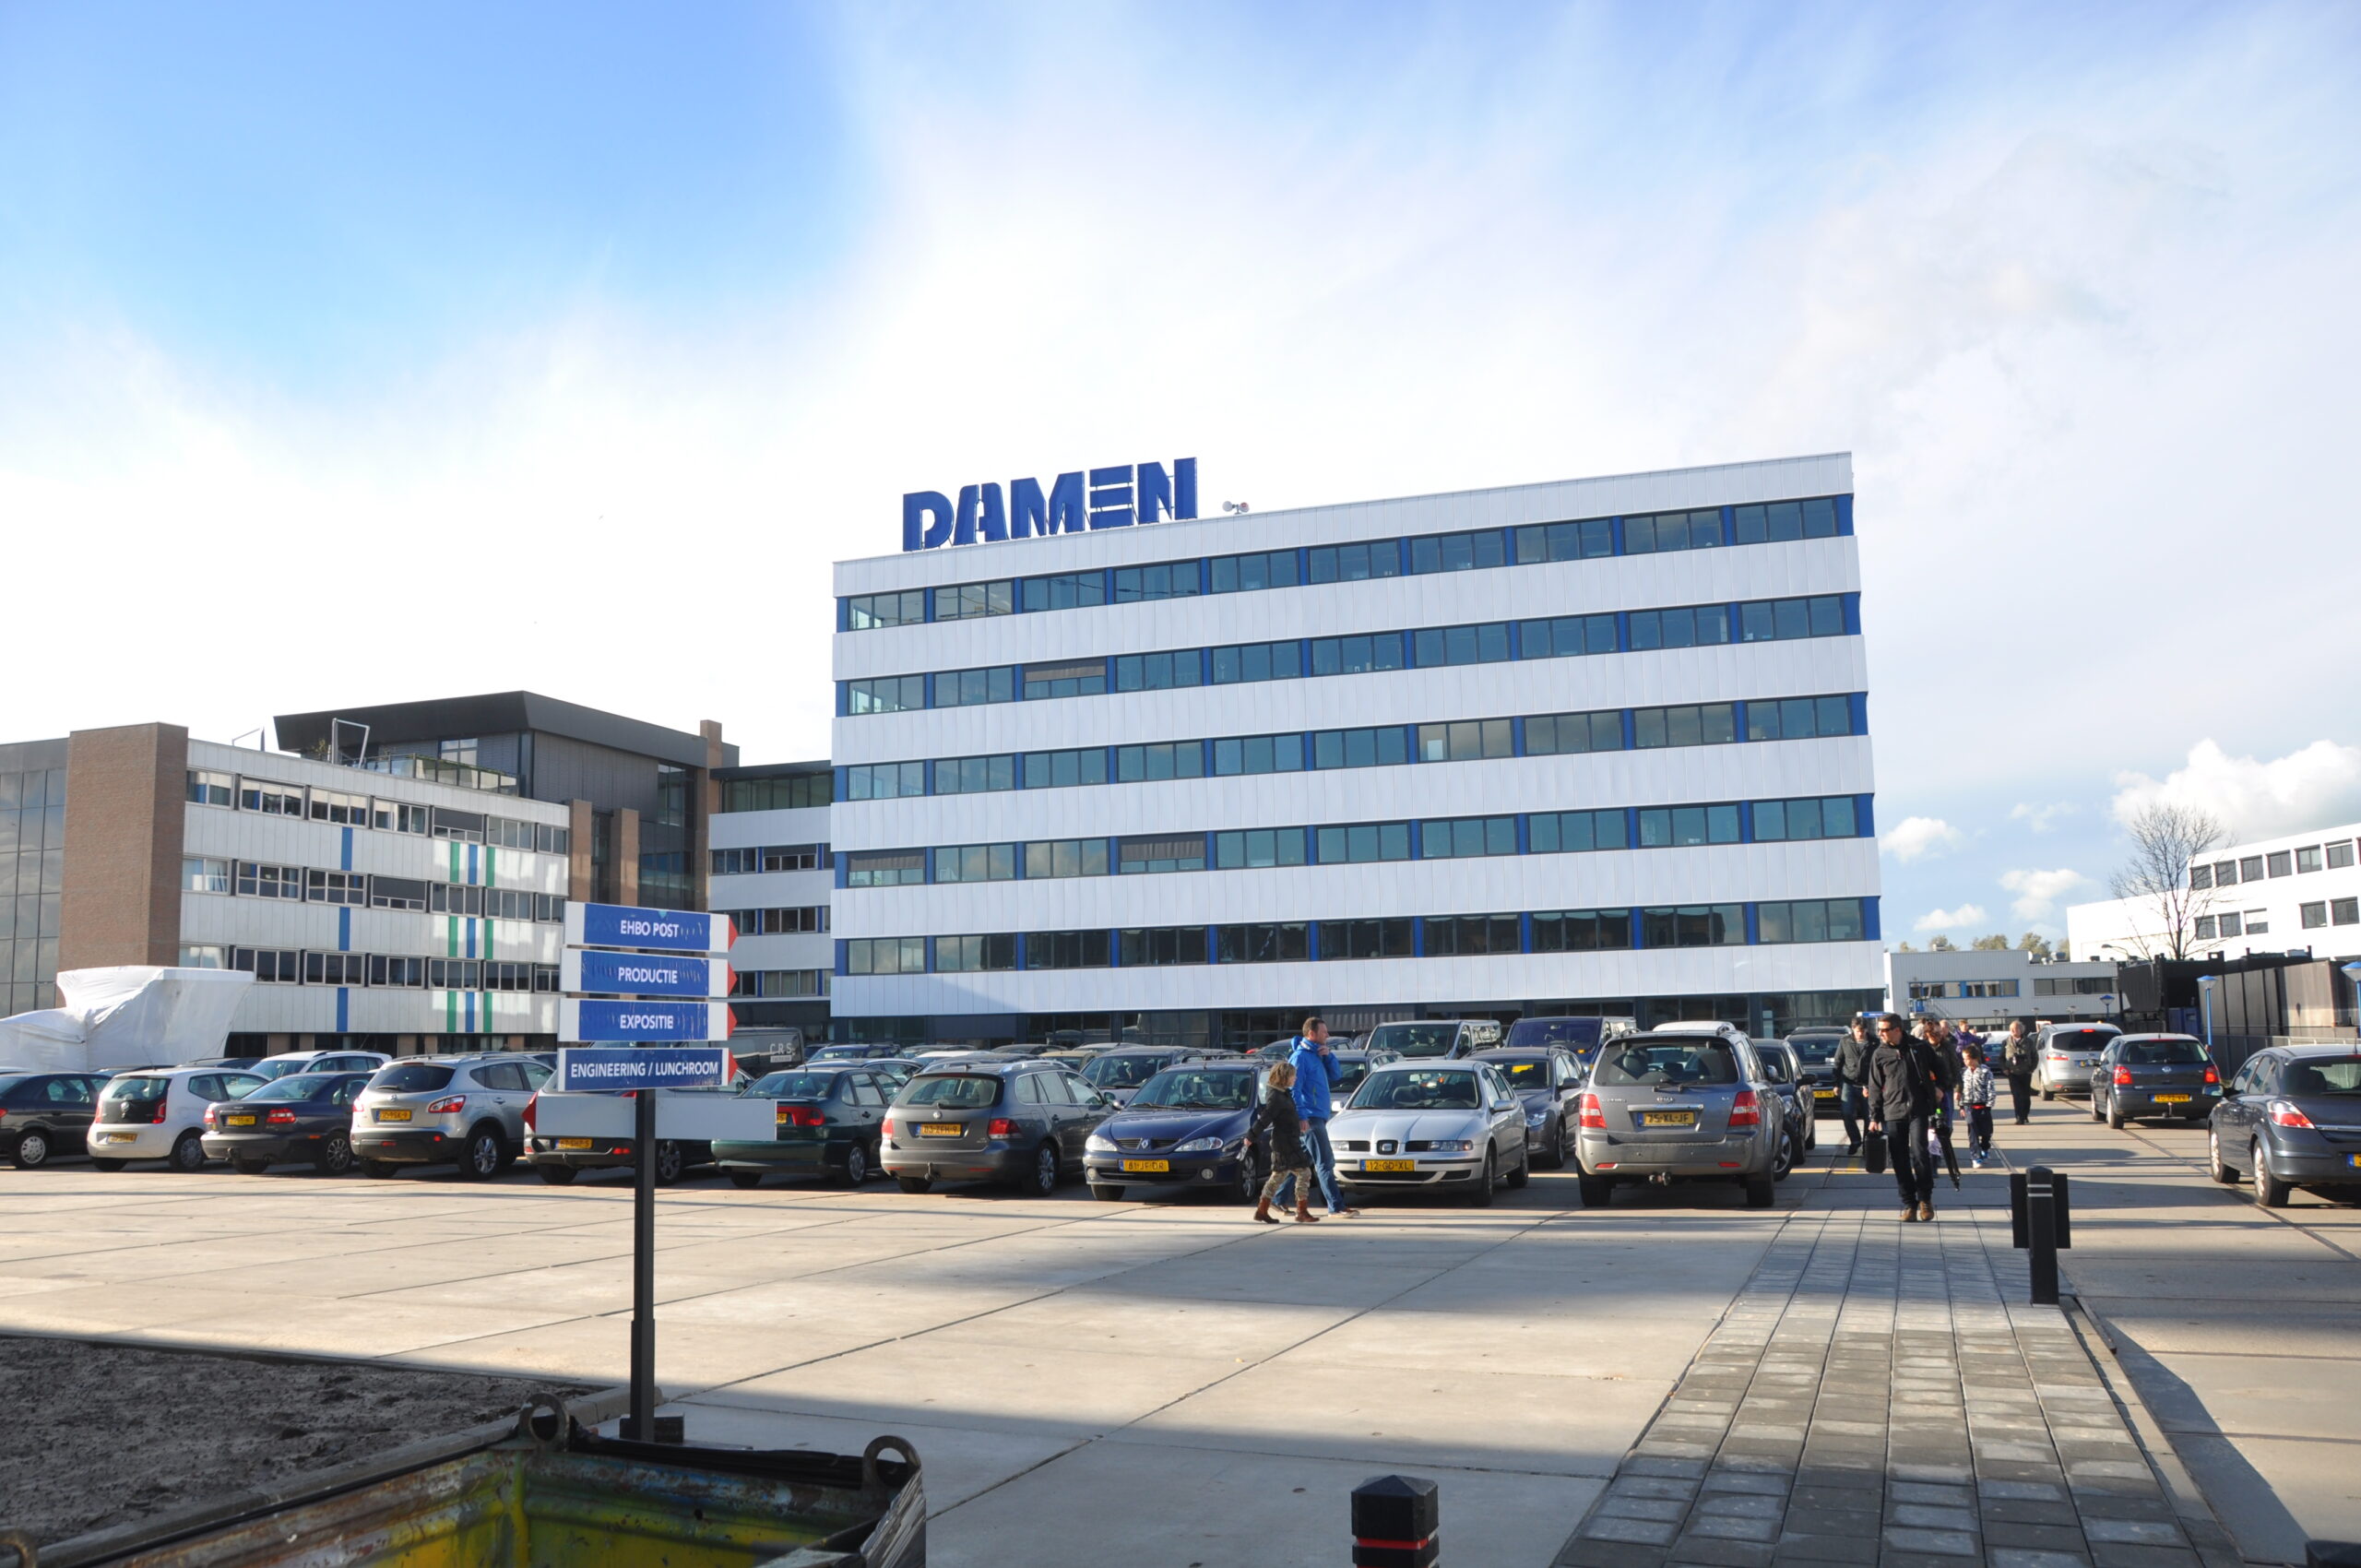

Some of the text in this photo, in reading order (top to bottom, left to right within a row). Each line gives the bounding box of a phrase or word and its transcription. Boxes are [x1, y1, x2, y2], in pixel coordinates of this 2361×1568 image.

[903, 457, 1198, 552] DAMEN
[620, 920, 680, 938] EHBO POST
[618, 967, 678, 984] PRODUCTIE
[619, 1015, 674, 1029] EXPOSITIE
[570, 1063, 647, 1078] ENGINEERING
[655, 1061, 718, 1076] LUNCHROOM
